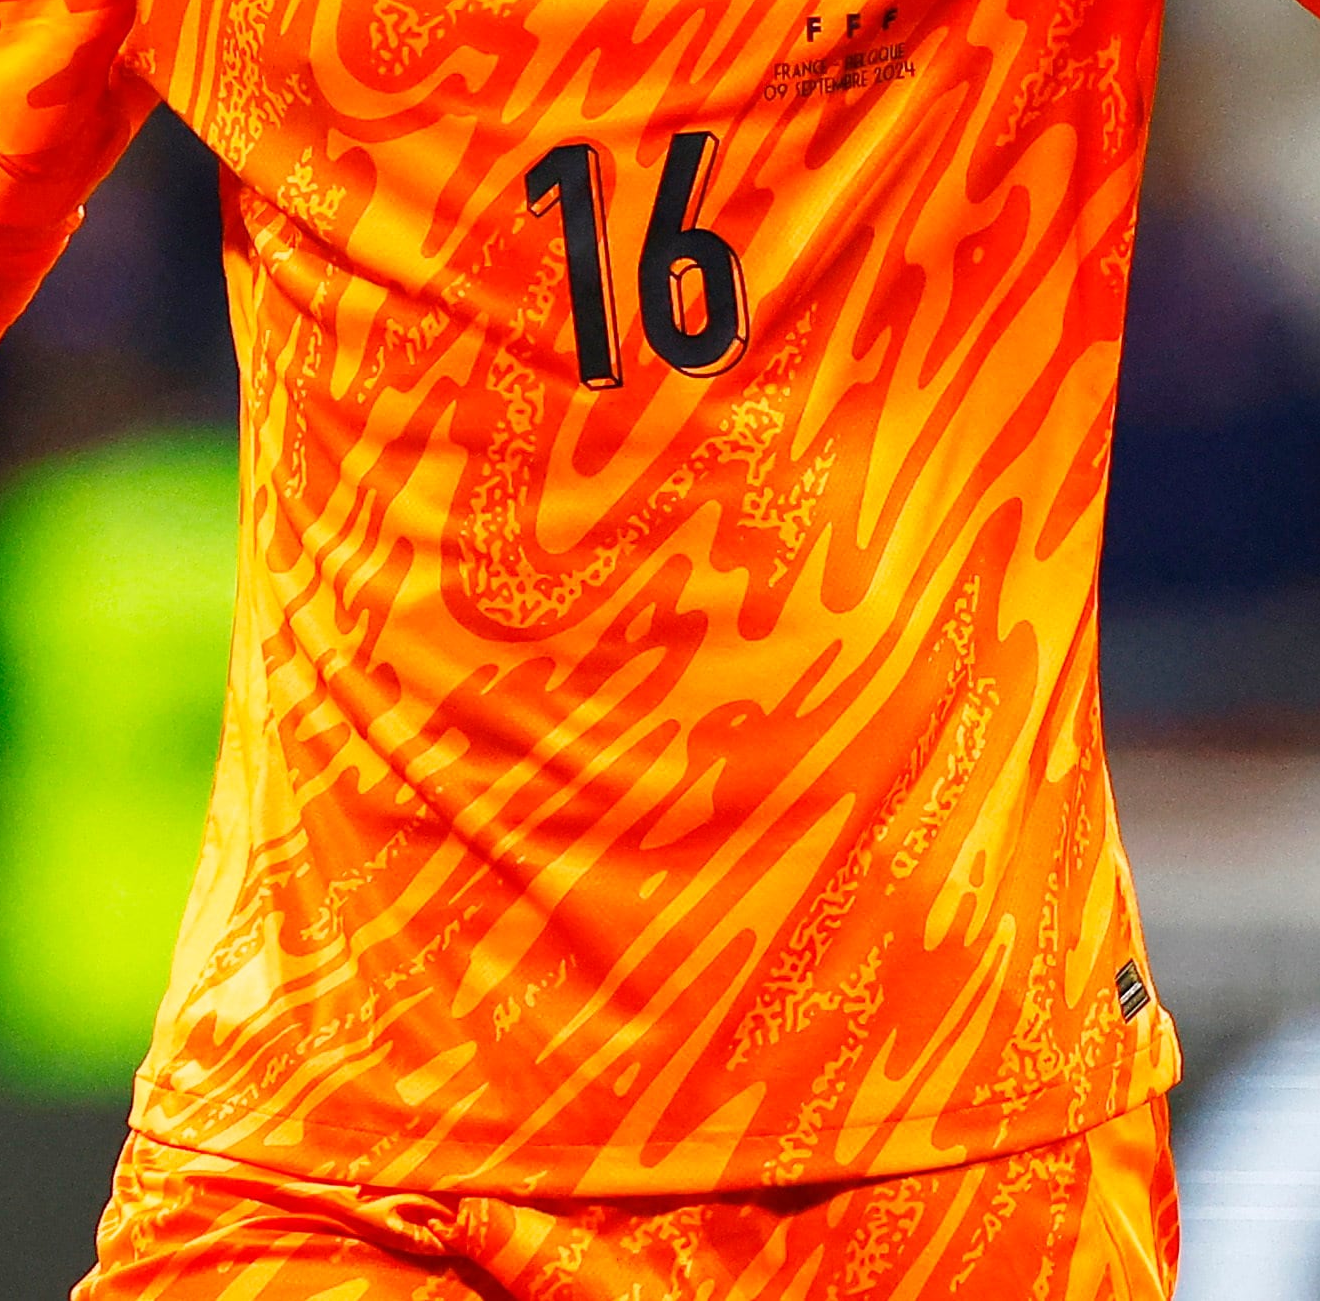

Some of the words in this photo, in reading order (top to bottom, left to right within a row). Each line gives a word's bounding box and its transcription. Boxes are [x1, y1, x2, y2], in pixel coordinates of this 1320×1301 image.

[763, 83, 788, 101] 09
[795, 70, 868, 97] SEPTEMBRE
[874, 62, 916, 84] 2024
[774, 59, 827, 80] FRANCE
[525, 131, 750, 390] 16
